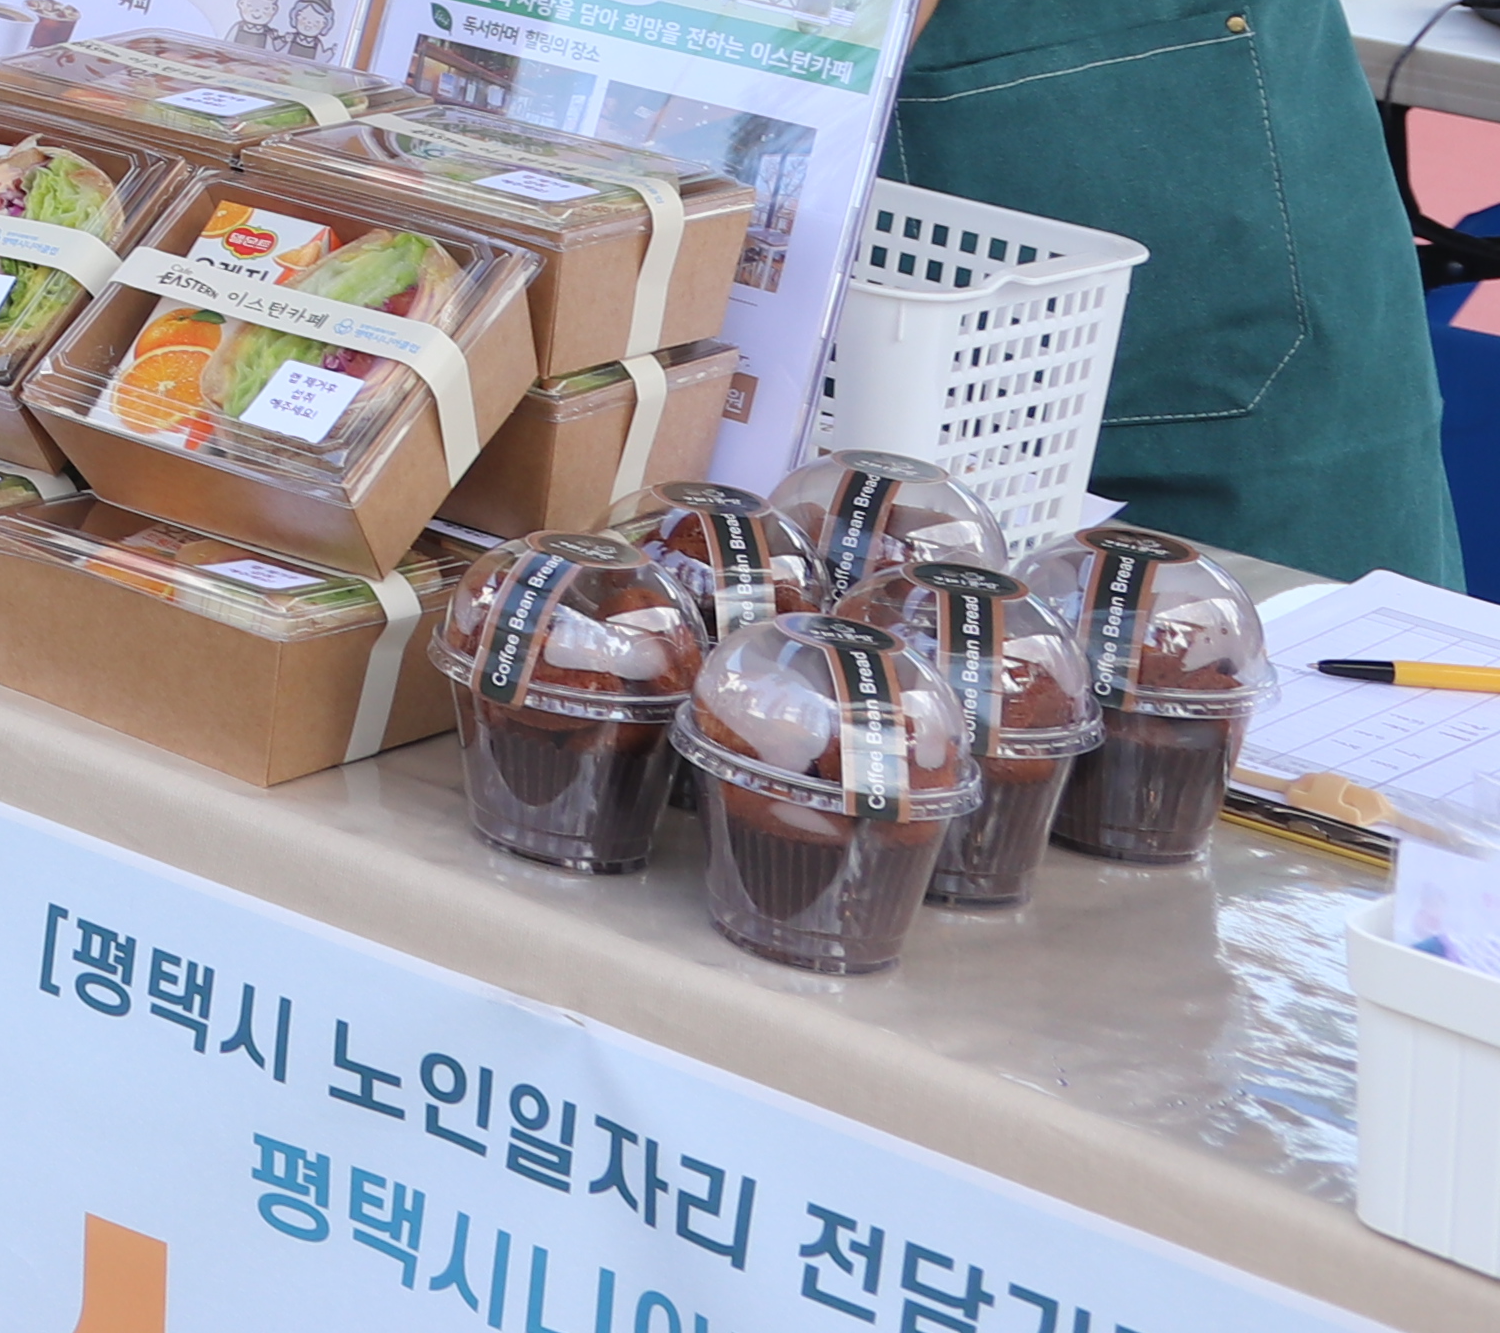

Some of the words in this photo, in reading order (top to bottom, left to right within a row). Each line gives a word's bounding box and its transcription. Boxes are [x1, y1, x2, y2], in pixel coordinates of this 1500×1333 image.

[461, 13, 521, 47] 독서하며
[523, 28, 569, 59] 힐링의
[570, 39, 603, 64] 장소
[579, 0, 621, 33] 담아
[621, 10, 684, 47] 희망을
[685, 25, 746, 61] 전하는
[749, 41, 856, 86] 이스턴카페
[155, 270, 220, 300] EASTERN
[226, 291, 331, 331] 이스턴카페
[854, 473, 881, 509] Bread
[722, 513, 744, 551] Bread
[842, 509, 867, 547] Bean
[733, 553, 753, 595] Bean
[1110, 555, 1136, 594] Bread
[490, 632, 520, 689] Coffee
[508, 590, 537, 632] Bean
[528, 554, 565, 590] Bread
[962, 595, 981, 635] Bread
[1102, 595, 1126, 639] Bean
[850, 650, 878, 695] Bread
[962, 638, 980, 683] Bean
[1094, 642, 1118, 697] Coffee
[866, 699, 883, 745] Bean
[867, 748, 887, 811] Coffee
[36, 900, 295, 1085] [평택시
[327, 1017, 759, 1273] 노인일자리
